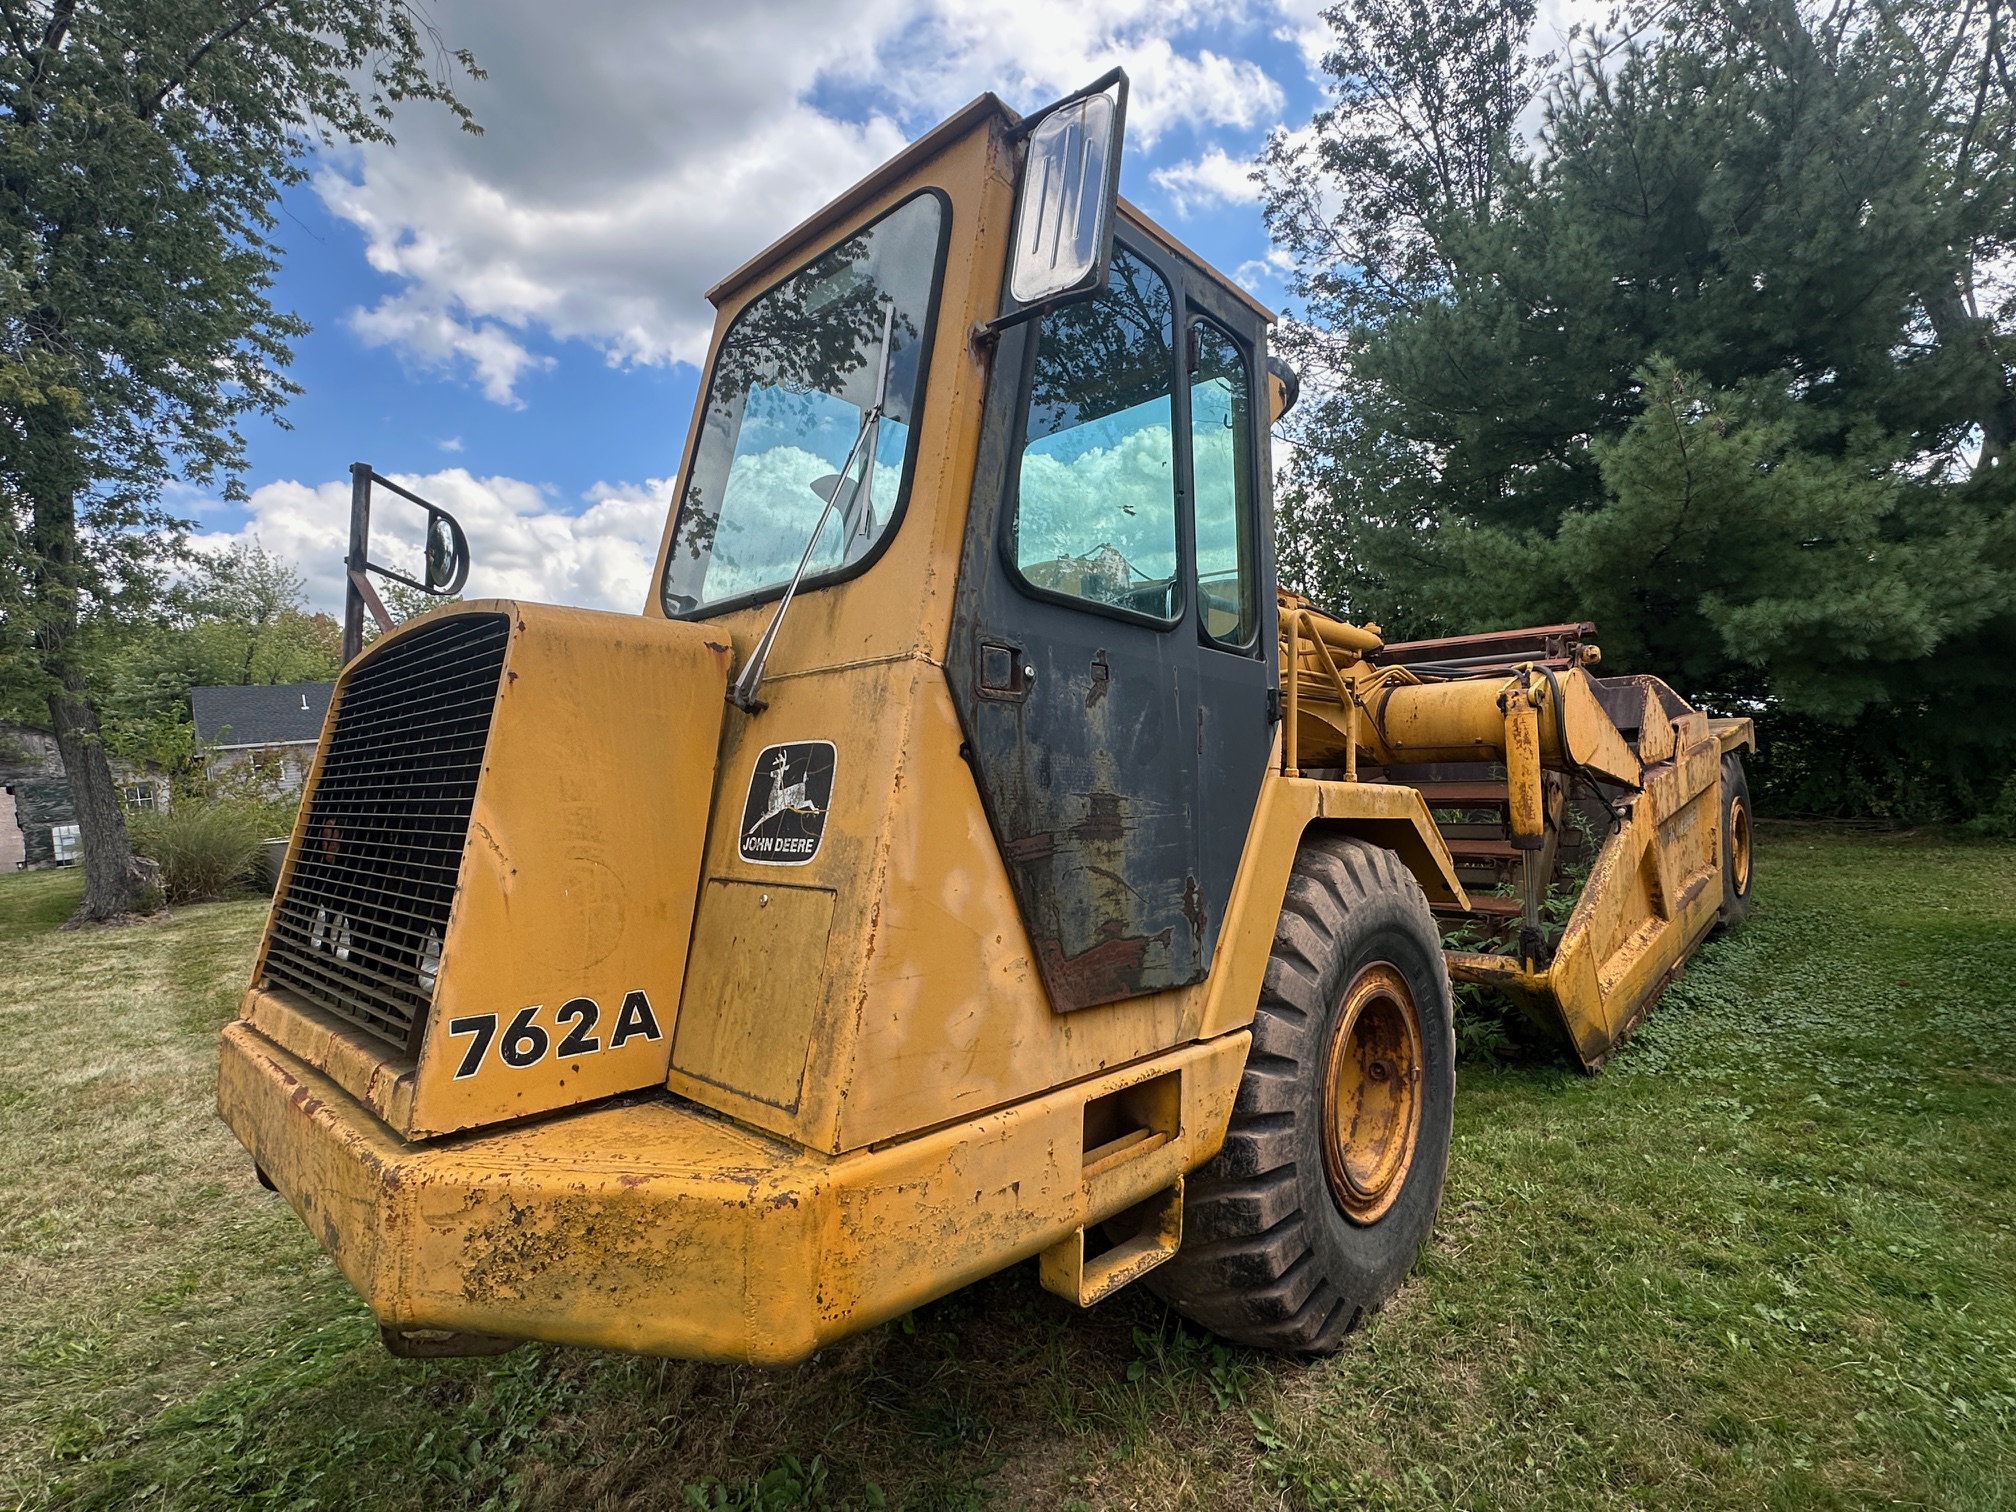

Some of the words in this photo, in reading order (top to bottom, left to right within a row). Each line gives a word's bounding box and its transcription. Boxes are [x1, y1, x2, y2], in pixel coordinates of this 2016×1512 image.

[744, 837, 773, 852] JOHN
[775, 838, 814, 853] DEERE
[449, 989, 663, 1081] 762A
